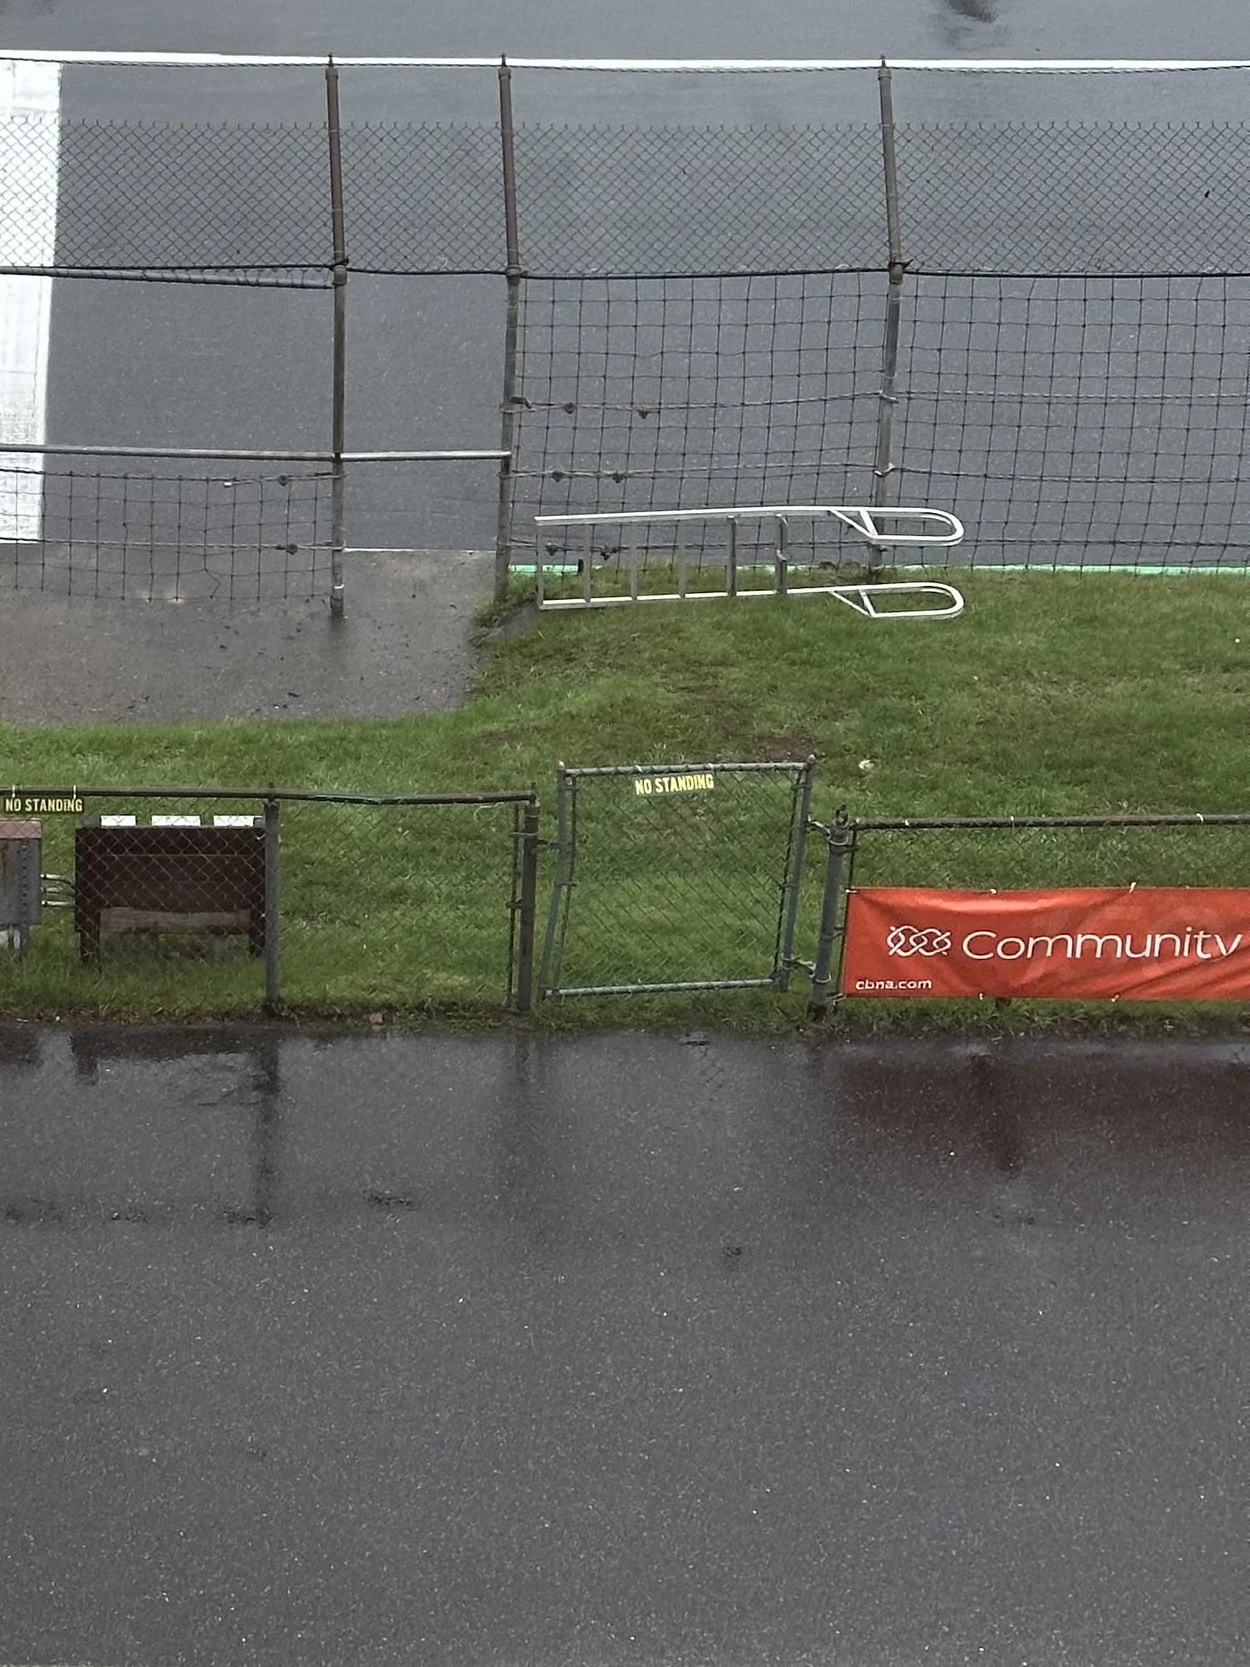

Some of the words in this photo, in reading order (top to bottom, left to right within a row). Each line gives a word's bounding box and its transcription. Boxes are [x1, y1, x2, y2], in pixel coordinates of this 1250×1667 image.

[634, 778, 653, 795] NO
[654, 773, 715, 793] STANDING
[5, 798, 22, 812] NO
[24, 798, 83, 812] STANDING
[962, 926, 1243, 961] Community
[855, 979, 932, 990] cbna.com
